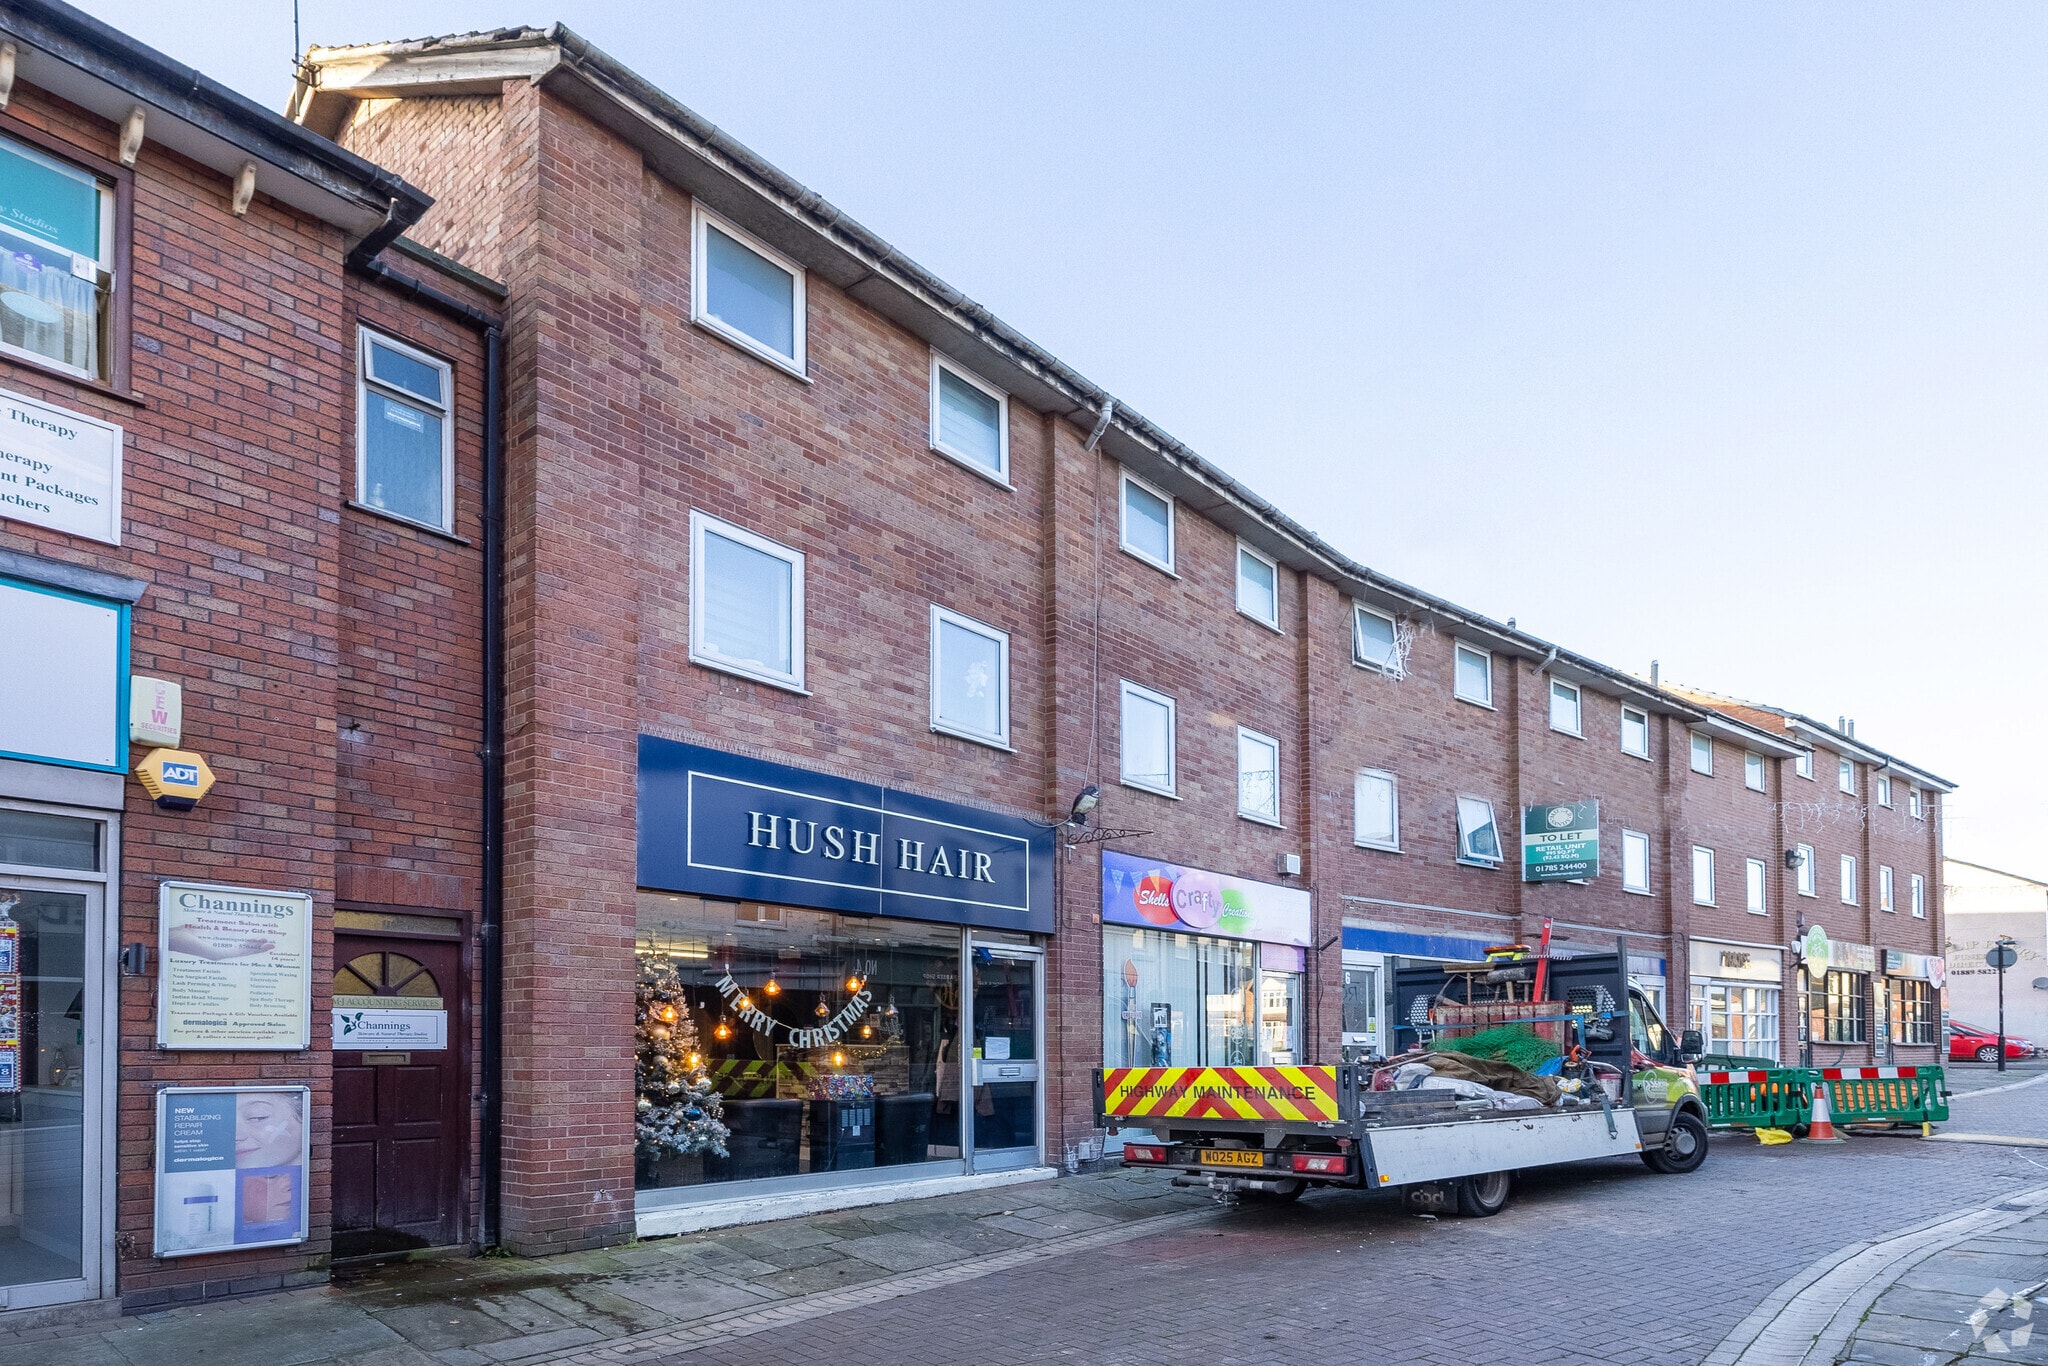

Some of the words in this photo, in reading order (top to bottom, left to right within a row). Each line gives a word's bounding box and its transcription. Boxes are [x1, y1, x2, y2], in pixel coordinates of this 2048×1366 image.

[10, 208, 58, 234] Studios
[7, 407, 78, 440] Therapy
[25, 475, 99, 507] Packages
[140, 721, 178, 735] SECURITIES
[163, 766, 198, 782] ADT
[1540, 834, 1557, 842] TO
[1560, 831, 1583, 841] LET
[748, 810, 880, 866] HUSH
[899, 838, 996, 884] HAIR
[1564, 842, 1586, 850] UNIT
[1535, 864, 1558, 872] 01785
[1559, 862, 1588, 870] 244400
[178, 893, 294, 919] Channings
[1139, 889, 1170, 907] Shells
[1176, 889, 1221, 918] Crafty
[196, 917, 236, 925] Treatment
[222, 926, 250, 934] Beauty
[1345, 971, 1351, 985] 6
[1977, 968, 2007, 976] 58224
[347, 999, 402, 1008] ACCOUNTING
[403, 1000, 440, 1008] SERVICES
[715, 974, 777, 1037] MERRY
[789, 988, 873, 1049] CHRISTMAS
[182, 1019, 228, 1027] dermalogica
[357, 1020, 411, 1032] Channings
[1120, 1085, 1189, 1098] HIGHWAY
[1193, 1086, 1316, 1100] MAINTENANCE
[174, 1129, 203, 1137] CREAM
[1236, 1152, 1258, 1164] AGZ
